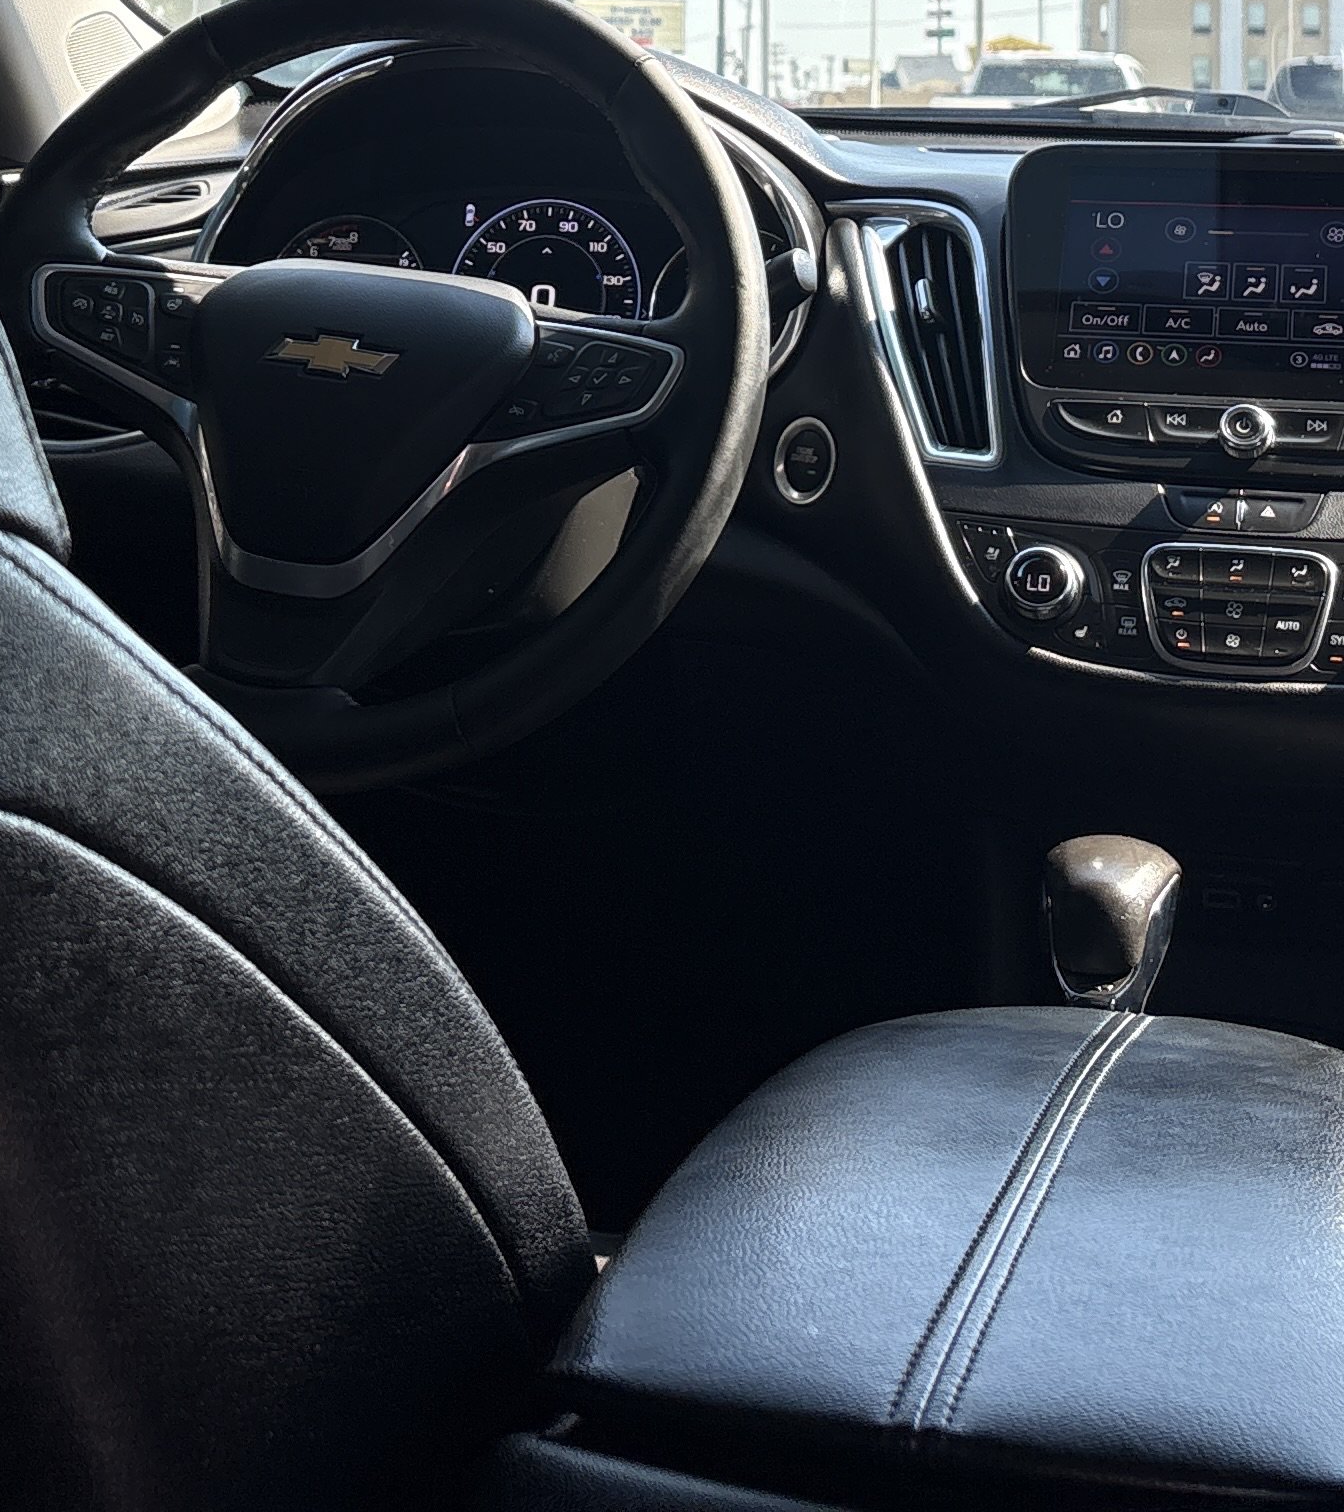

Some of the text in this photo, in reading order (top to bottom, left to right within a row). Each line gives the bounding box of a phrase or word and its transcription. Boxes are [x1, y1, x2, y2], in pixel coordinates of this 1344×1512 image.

[517, 221, 536, 232] 70
[558, 221, 579, 233] 90
[1095, 212, 1125, 229] LO
[486, 242, 506, 253] 50
[589, 242, 608, 253] 110
[602, 275, 623, 286] 130
[1082, 313, 1129, 328] On/Off
[1165, 316, 1191, 330] A/C
[1235, 320, 1268, 333] Auto
[1026, 574, 1051, 592] LO
[1275, 619, 1301, 633] AUTO
